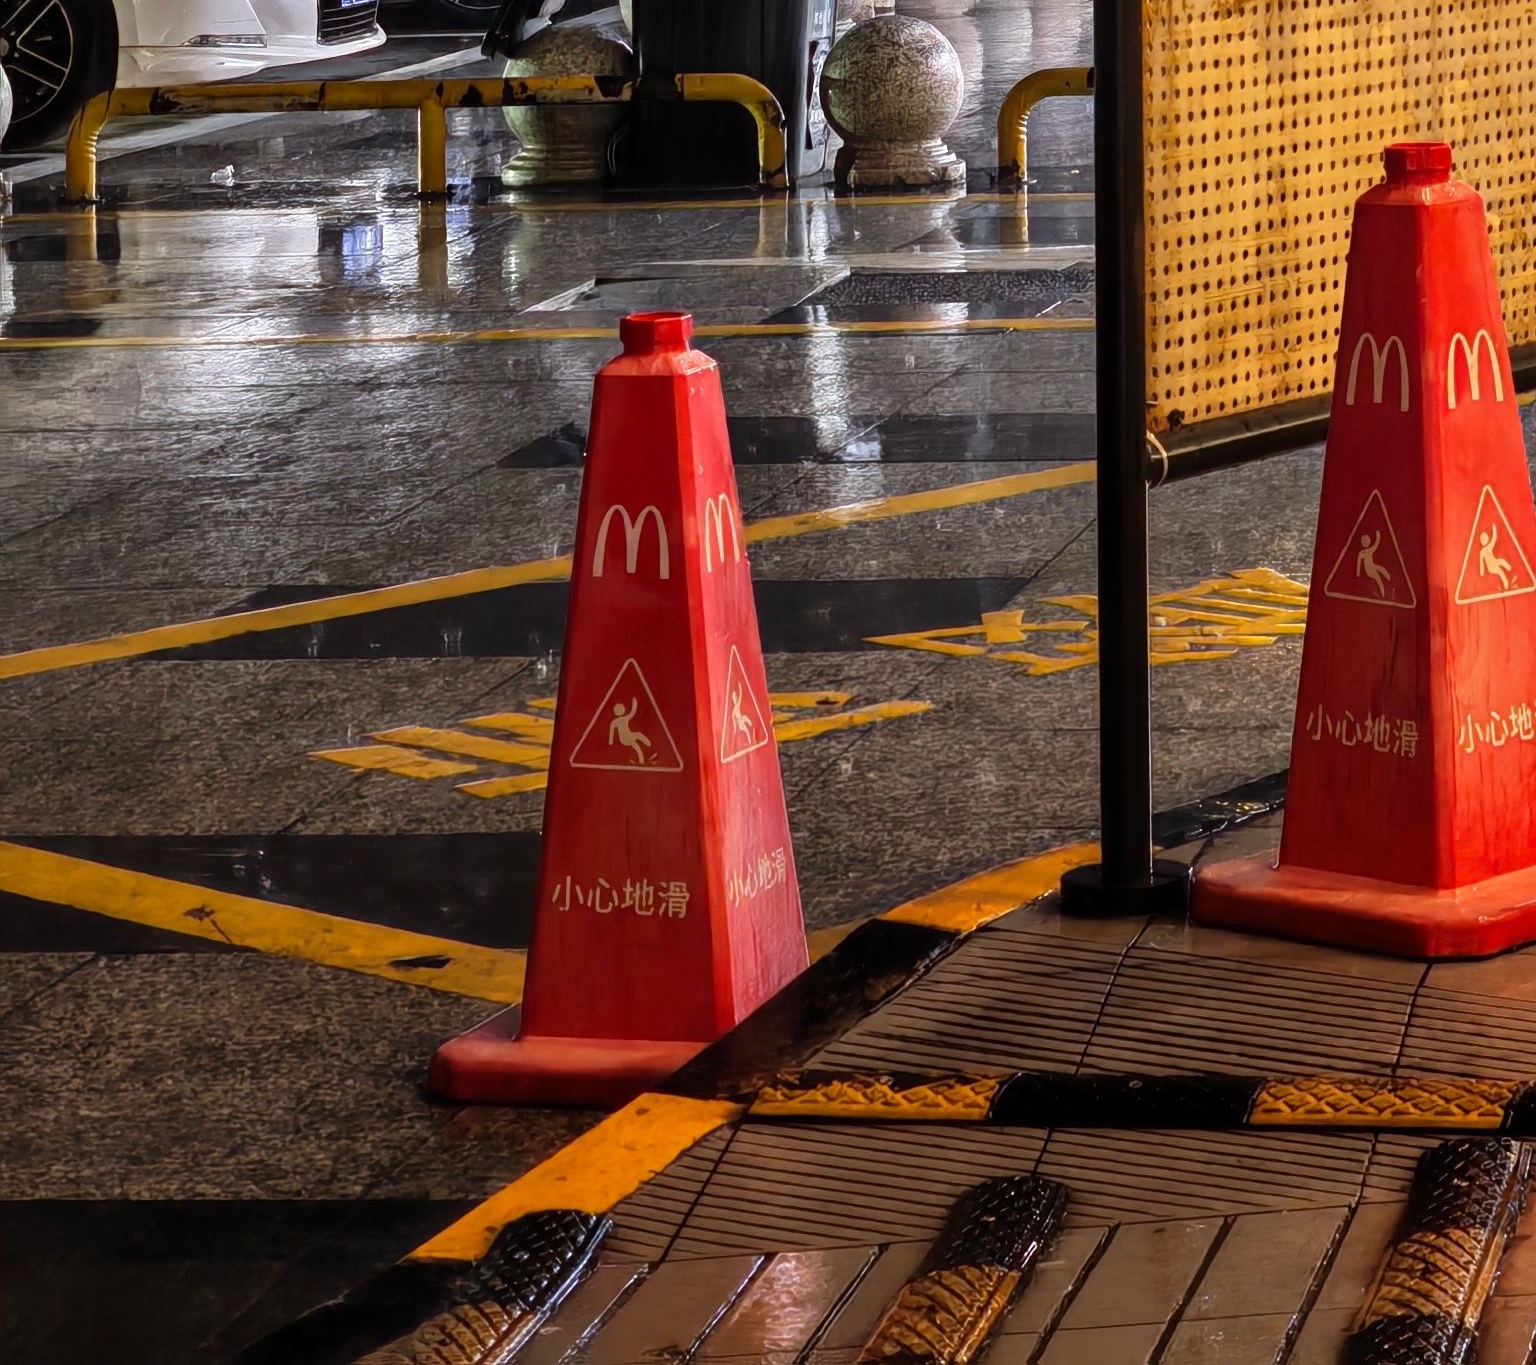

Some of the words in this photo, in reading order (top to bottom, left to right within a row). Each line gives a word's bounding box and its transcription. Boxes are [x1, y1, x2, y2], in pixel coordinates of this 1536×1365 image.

[1305, 703, 1419, 759] 小心地滑
[551, 875, 690, 919] 小心地滑
[727, 846, 786, 908] 小心地滑
